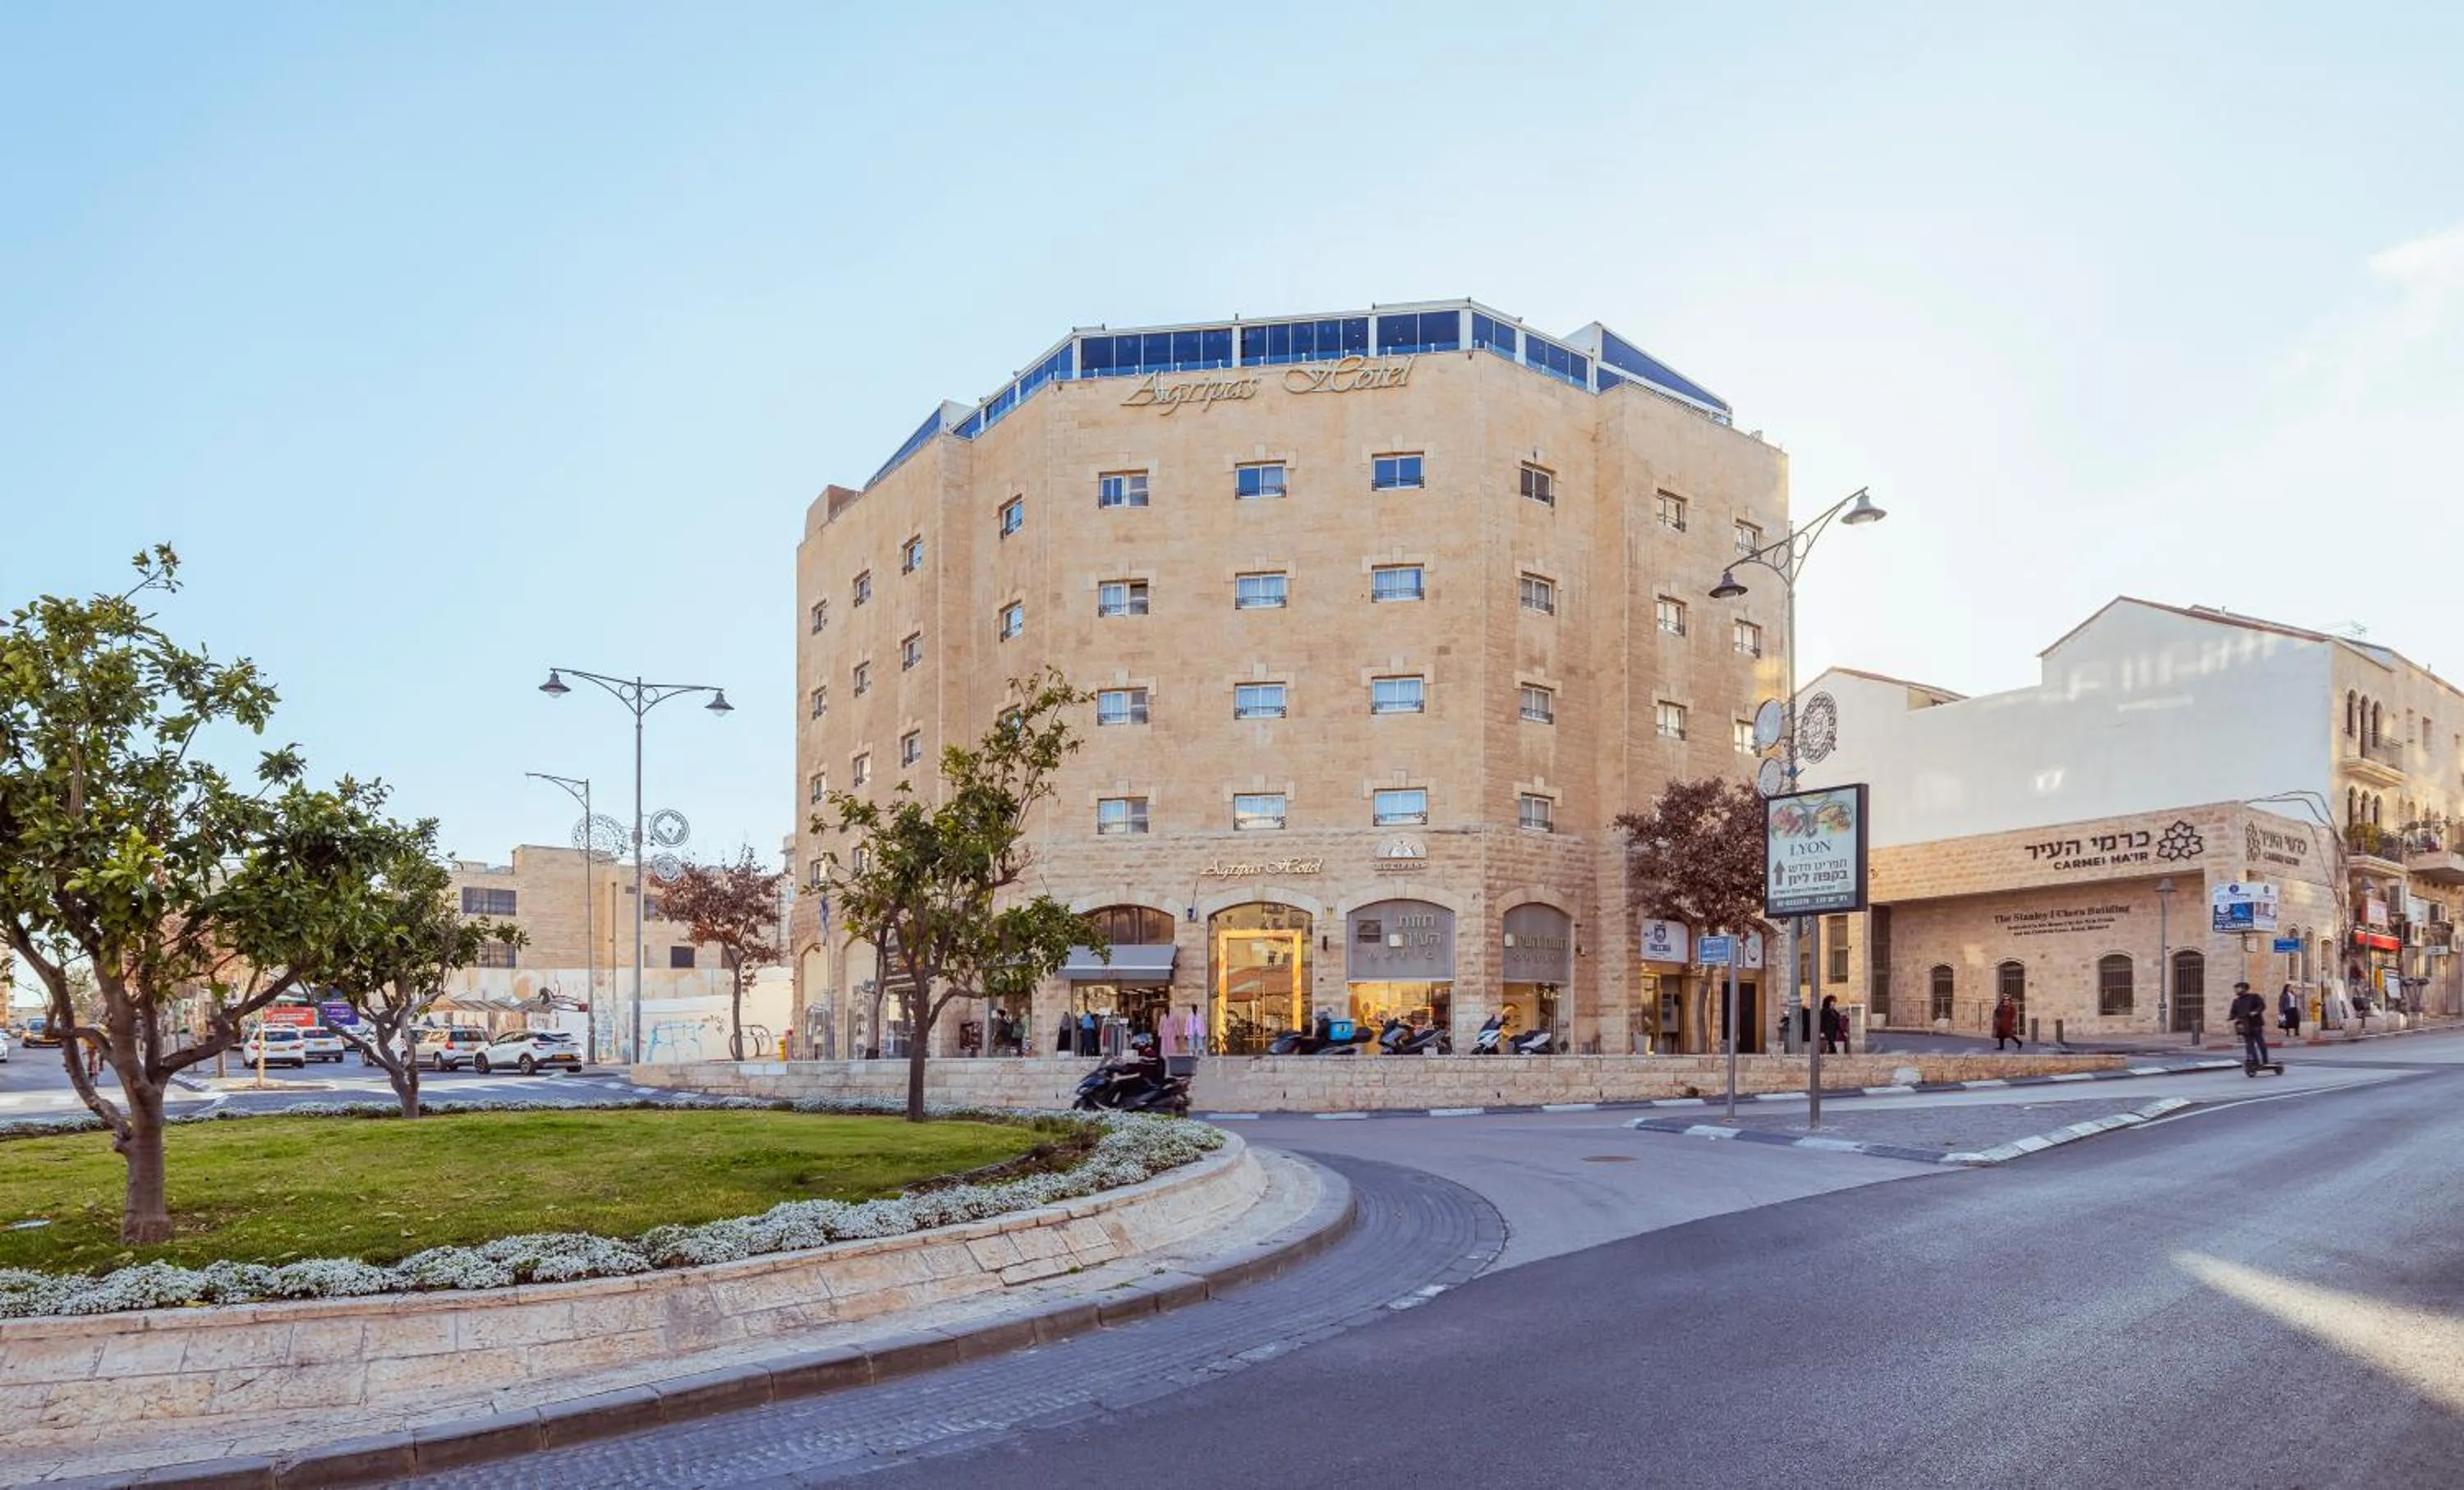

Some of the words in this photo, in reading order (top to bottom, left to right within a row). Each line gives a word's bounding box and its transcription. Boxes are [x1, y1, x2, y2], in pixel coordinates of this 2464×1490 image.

[1120, 370, 1261, 416] Agripas
[1282, 354, 1418, 393] Hotel
[1789, 840, 1832, 856] LYON
[2025, 839, 2080, 860] העיר
[2089, 830, 2150, 852] כרמי
[1200, 859, 1263, 881] Agripas
[1266, 857, 1325, 875] Hotel
[1787, 863, 1812, 873] חדש
[1814, 859, 1847, 871] תפריט
[2053, 856, 2106, 871] CARMEI
[2110, 852, 2149, 864] HA'IR
[1788, 872, 1809, 886] ליון
[1813, 870, 1848, 883] בקפה
[2014, 910, 2048, 922] Stanley
[2088, 904, 2131, 916] Building
